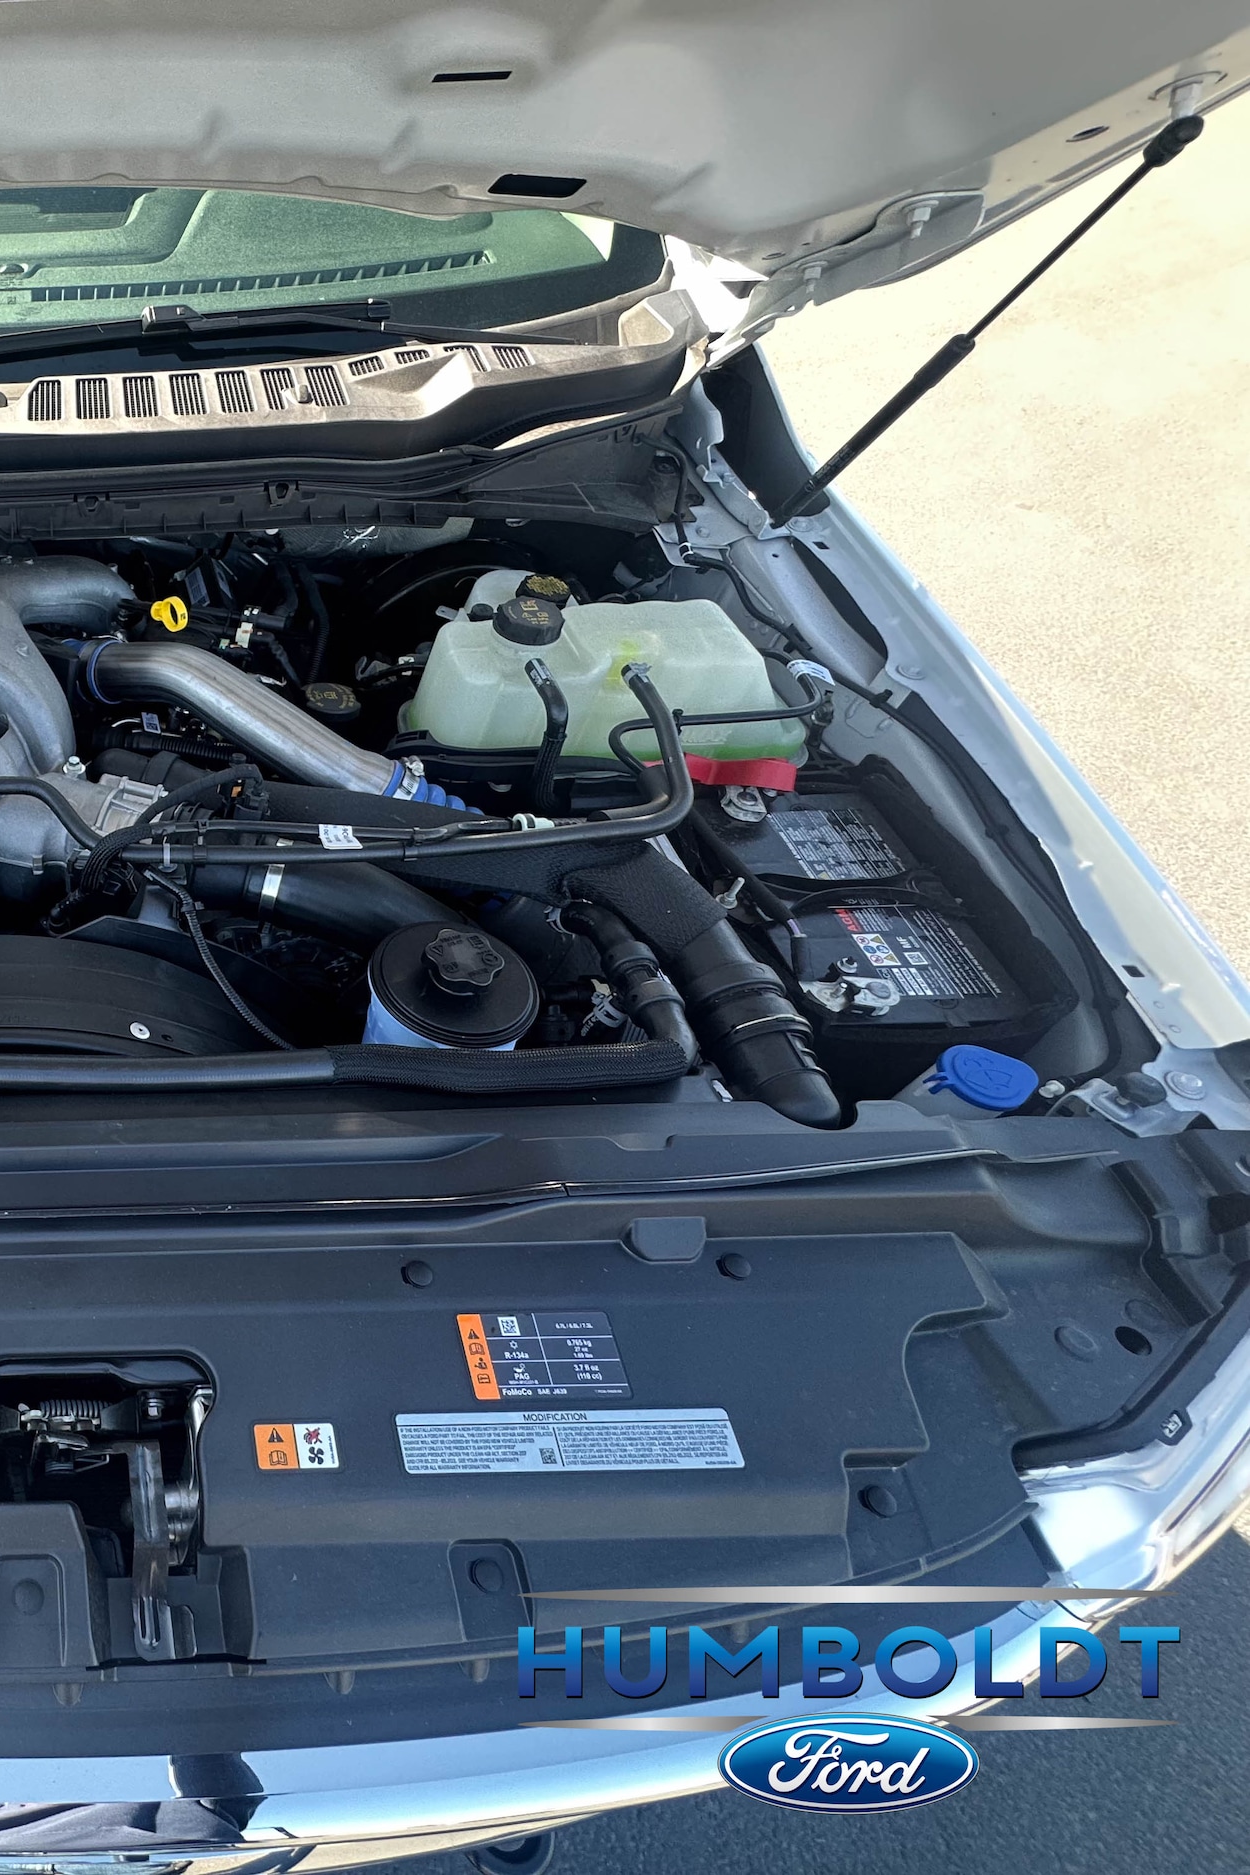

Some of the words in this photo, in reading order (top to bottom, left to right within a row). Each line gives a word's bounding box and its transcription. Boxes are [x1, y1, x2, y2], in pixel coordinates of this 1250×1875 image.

[504, 1351, 530, 1360] R-134a
[514, 1372, 530, 1380] PAG
[502, 1387, 532, 1396] FoMoCo
[523, 1413, 587, 1422] MODIFICATION
